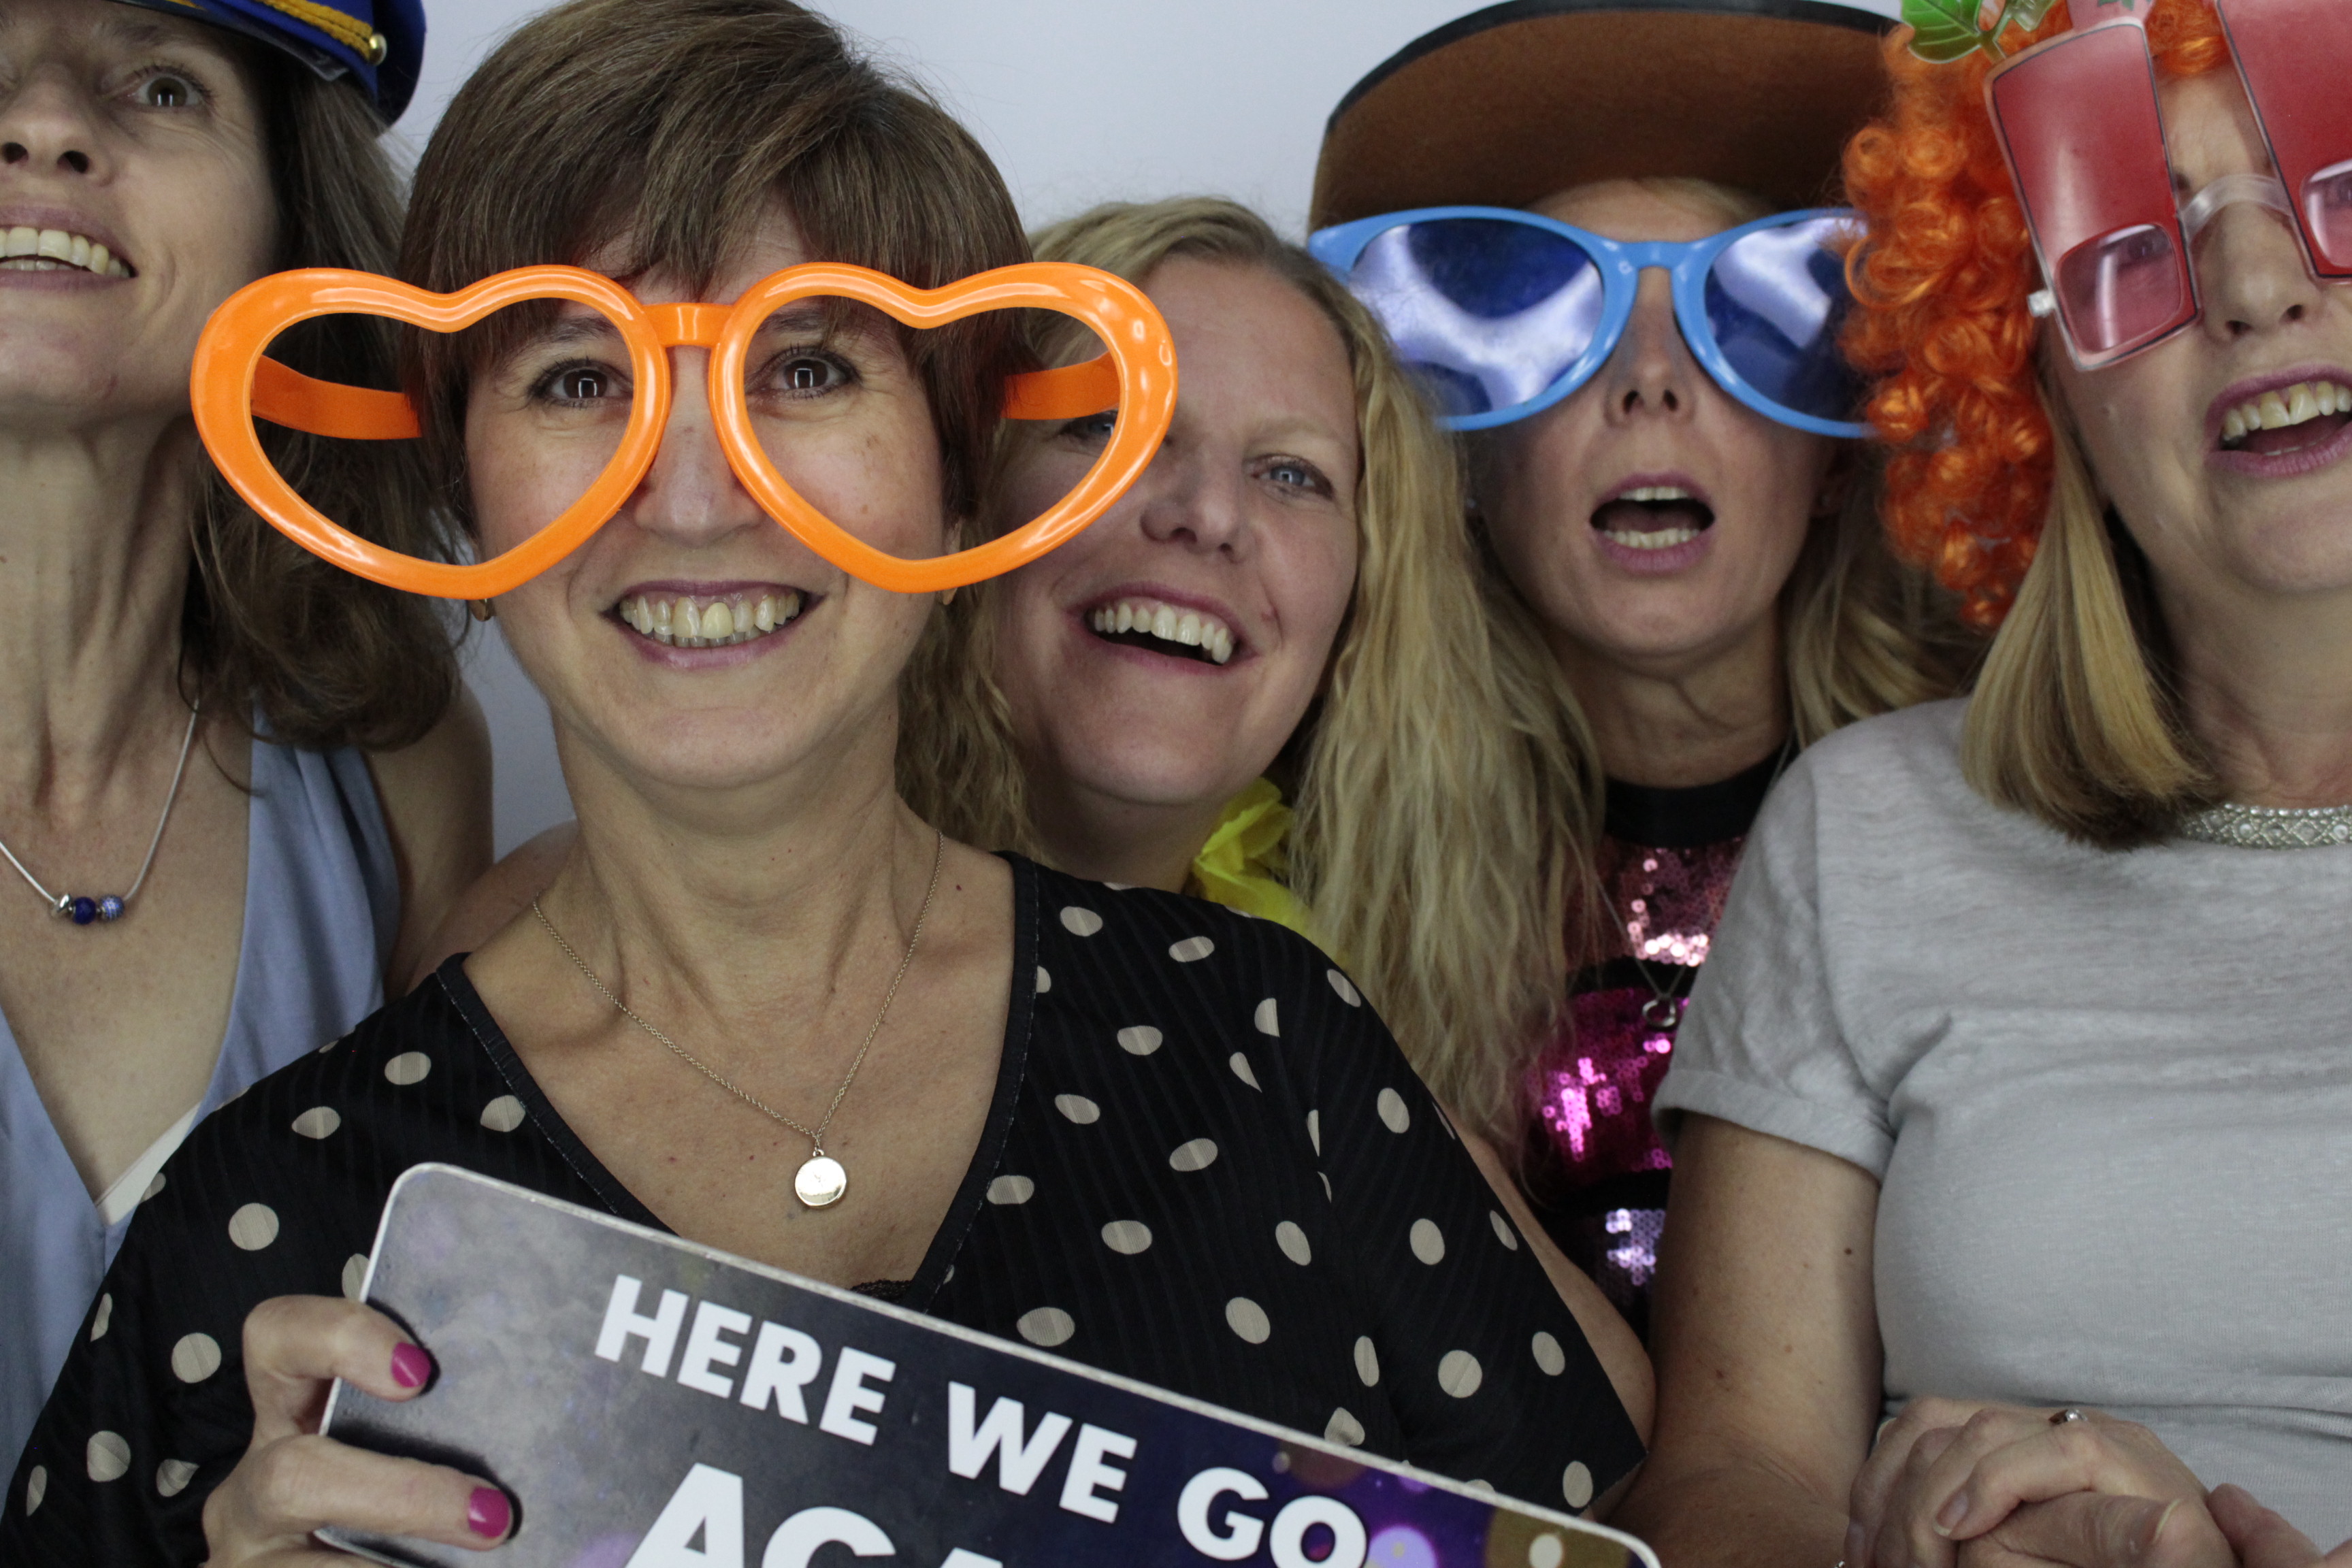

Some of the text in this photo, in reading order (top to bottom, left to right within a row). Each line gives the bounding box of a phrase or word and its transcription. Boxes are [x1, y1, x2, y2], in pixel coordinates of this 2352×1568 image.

[595, 1275, 894, 1444] HERE
[949, 1383, 1135, 1522] WE
[1179, 1469, 1365, 1568] GO
